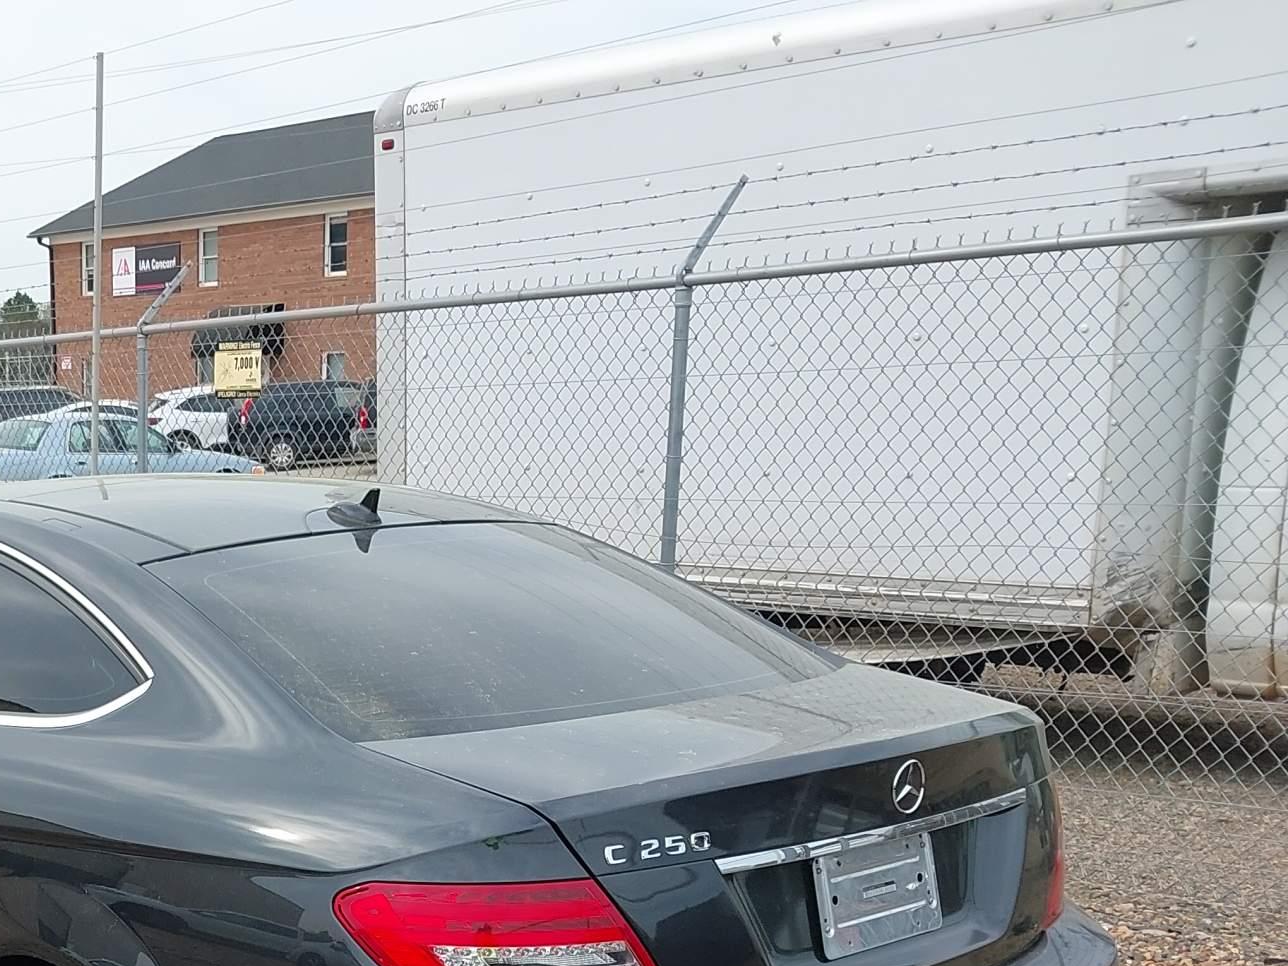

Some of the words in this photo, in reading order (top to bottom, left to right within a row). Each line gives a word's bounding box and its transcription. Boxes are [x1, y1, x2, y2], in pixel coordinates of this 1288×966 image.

[407, 104, 418, 115] DC
[420, 100, 439, 113] 3266
[441, 98, 447, 109] T
[139, 259, 151, 272] IAA
[152, 257, 176, 270] Concord
[234, 357, 253, 371] 7,000
[255, 356, 260, 369] V
[604, 844, 627, 865] C
[640, 831, 712, 860] 250
